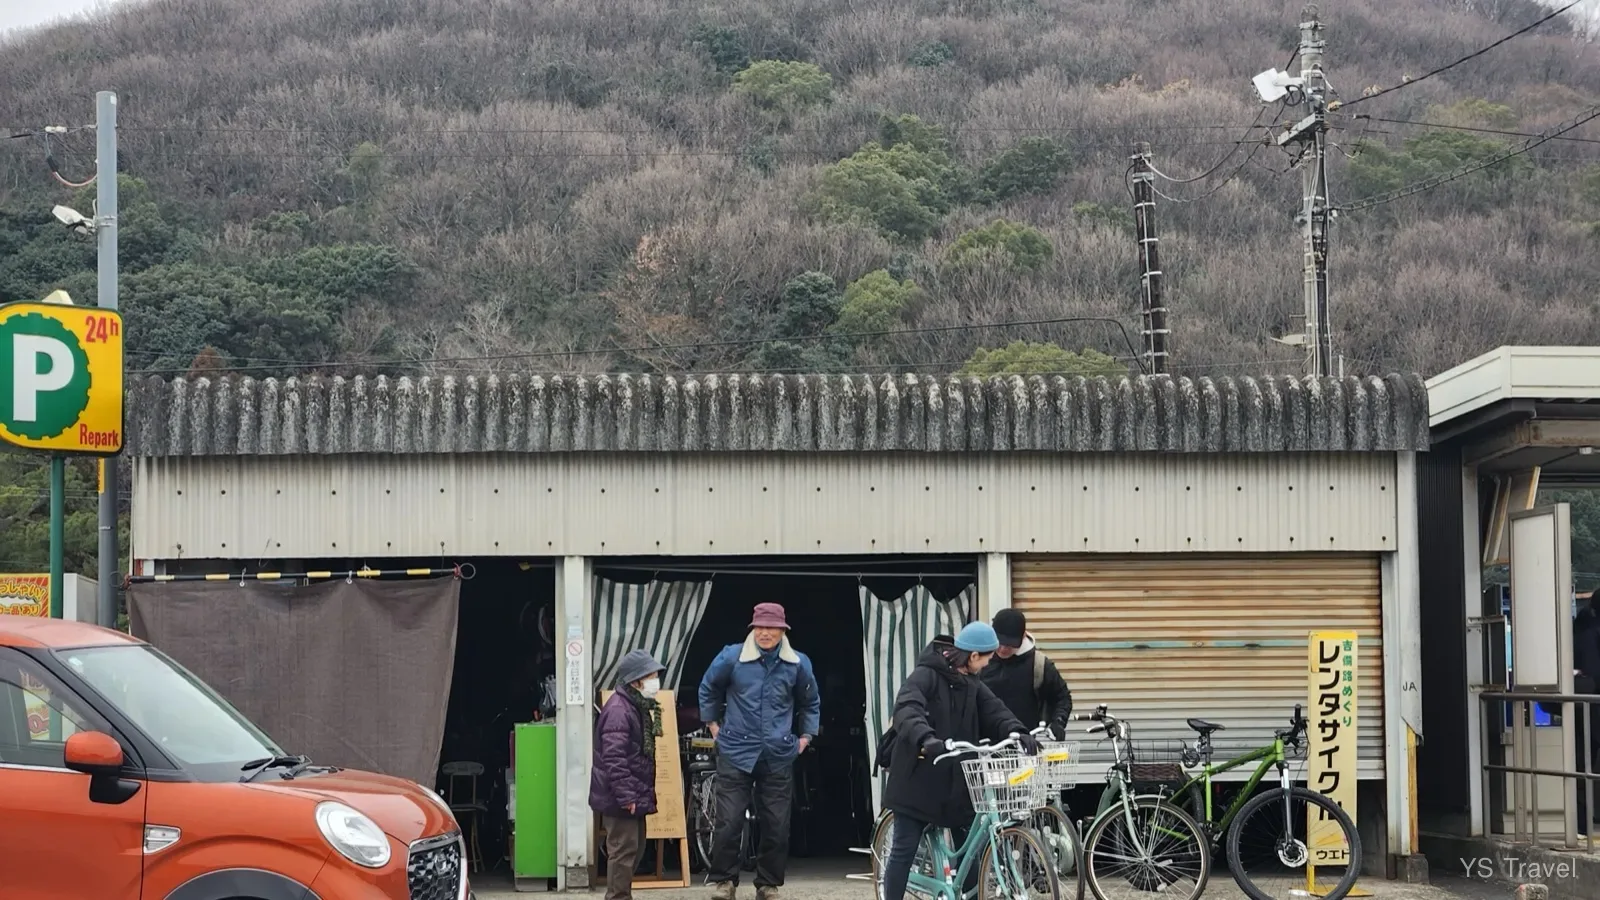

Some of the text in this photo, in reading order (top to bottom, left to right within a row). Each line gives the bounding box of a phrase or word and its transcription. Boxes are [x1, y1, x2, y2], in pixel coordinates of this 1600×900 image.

[85, 315, 119, 343] 24h
[13, 333, 75, 422] P
[79, 423, 119, 448] Repark
[1342, 639, 1353, 727] 吉備路めぐり
[1402, 681, 1418, 692] JA
